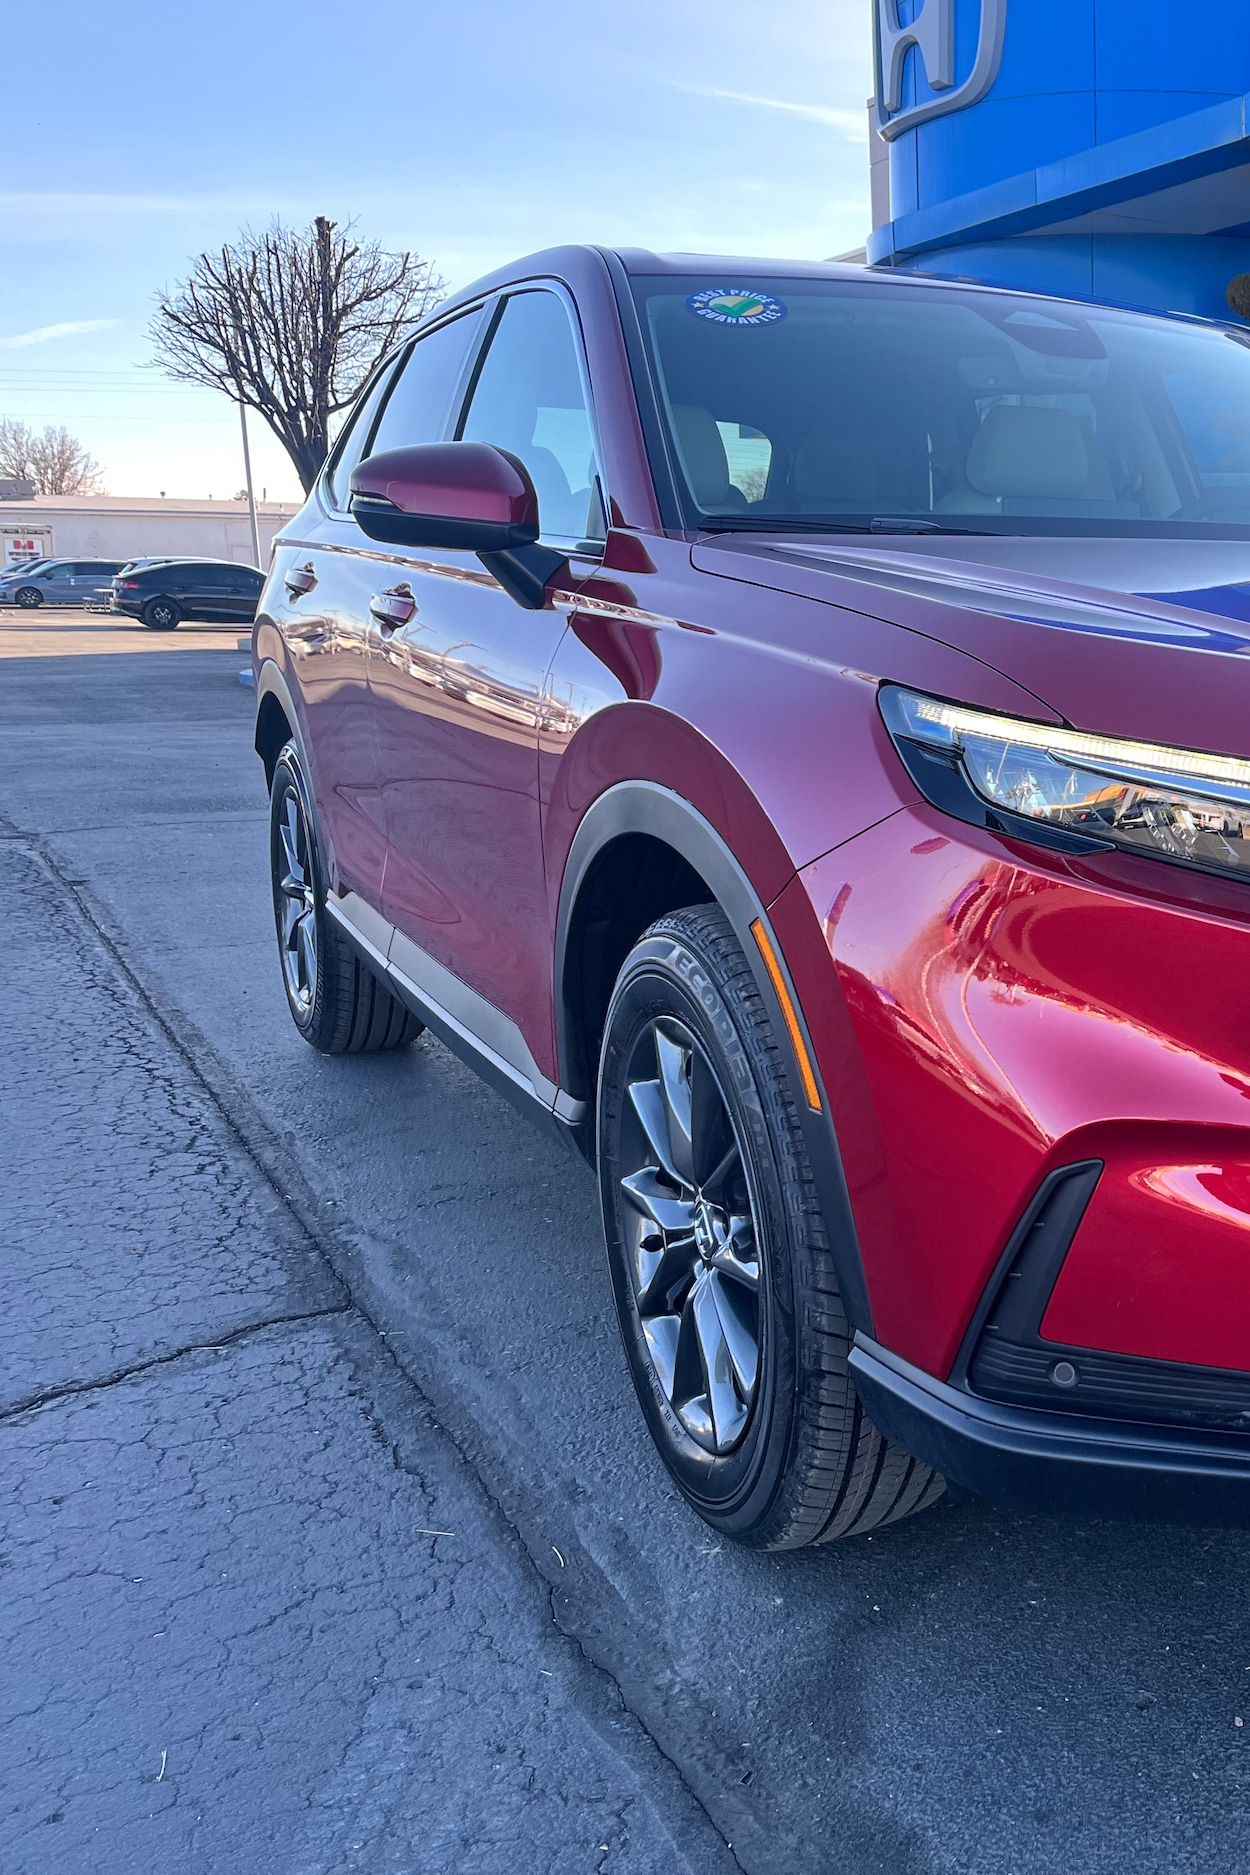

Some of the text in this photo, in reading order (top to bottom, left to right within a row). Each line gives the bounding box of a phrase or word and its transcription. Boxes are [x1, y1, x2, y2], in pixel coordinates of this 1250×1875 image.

[693, 289, 775, 303] BEST PRICE
[696, 308, 781, 324] GUARANTEE
[674, 949, 751, 1092] ECOPIA
